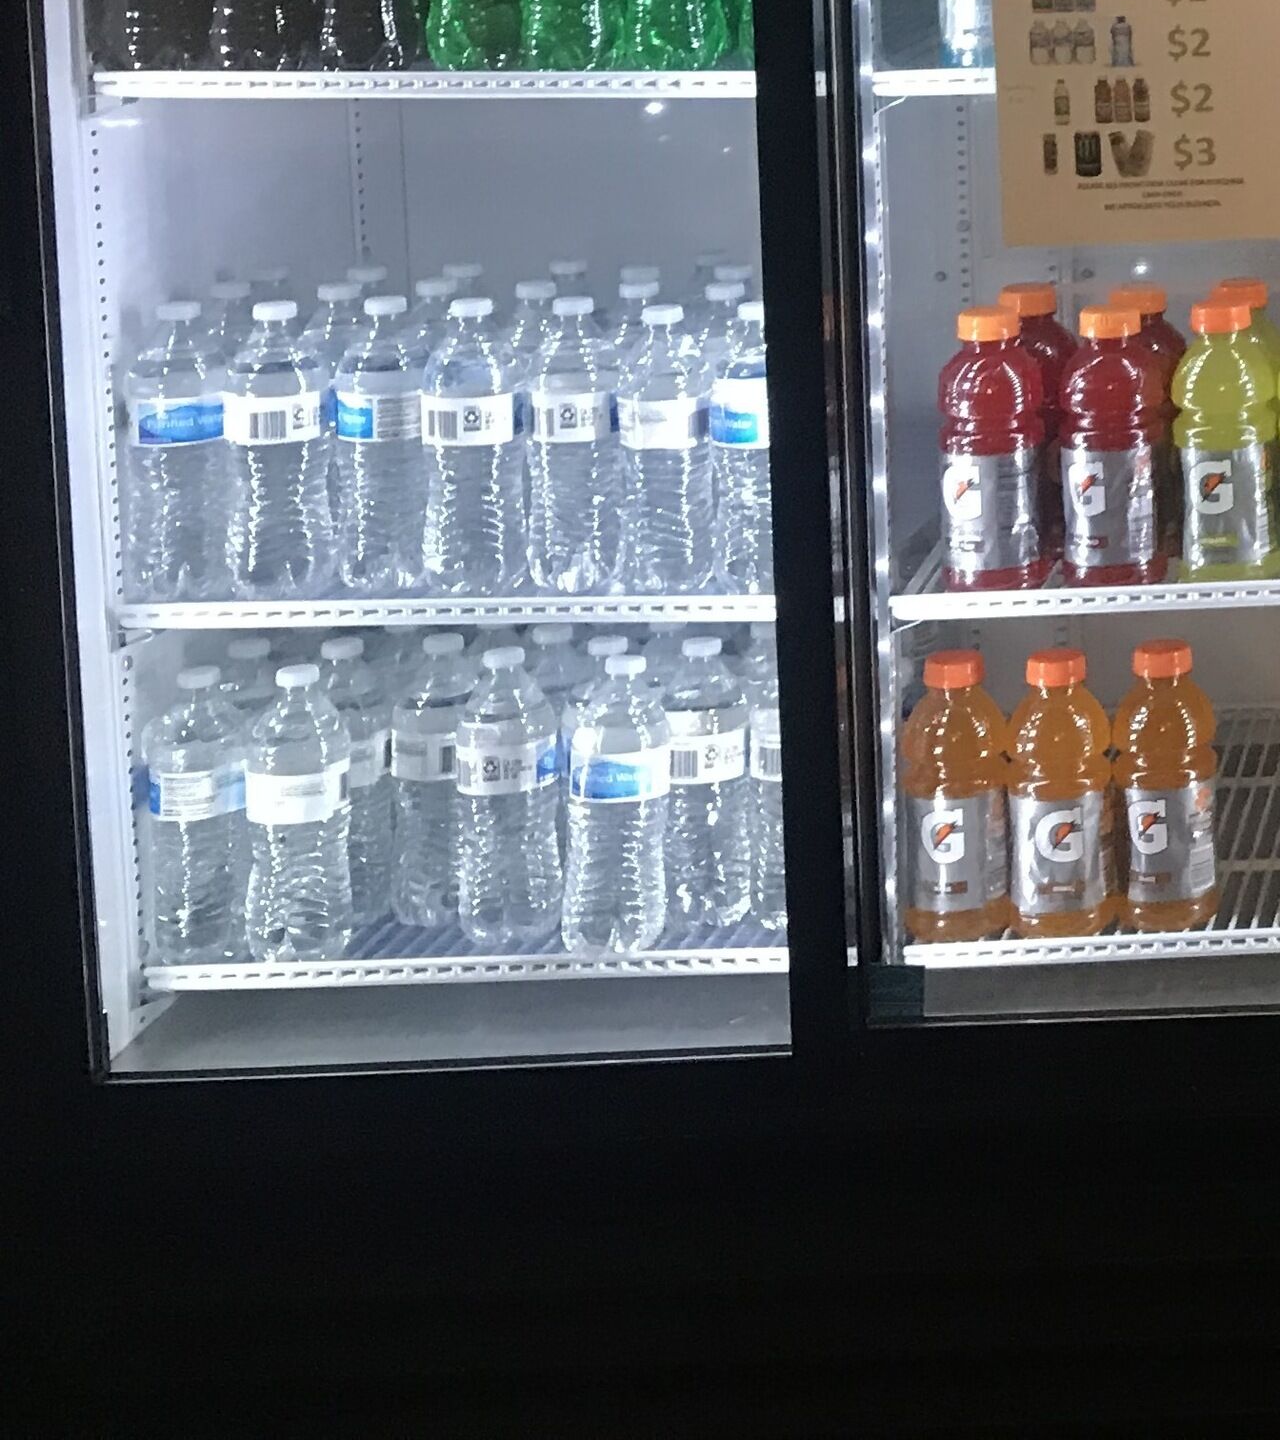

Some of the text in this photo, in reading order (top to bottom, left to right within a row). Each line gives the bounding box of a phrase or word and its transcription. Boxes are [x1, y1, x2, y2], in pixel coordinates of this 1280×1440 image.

[1167, 24, 1211, 62] $2
[1170, 79, 1214, 118] $2
[1173, 134, 1217, 171] $3
[921, 808, 965, 864] G
[1035, 806, 1085, 862] G
[1128, 799, 1168, 855] G
